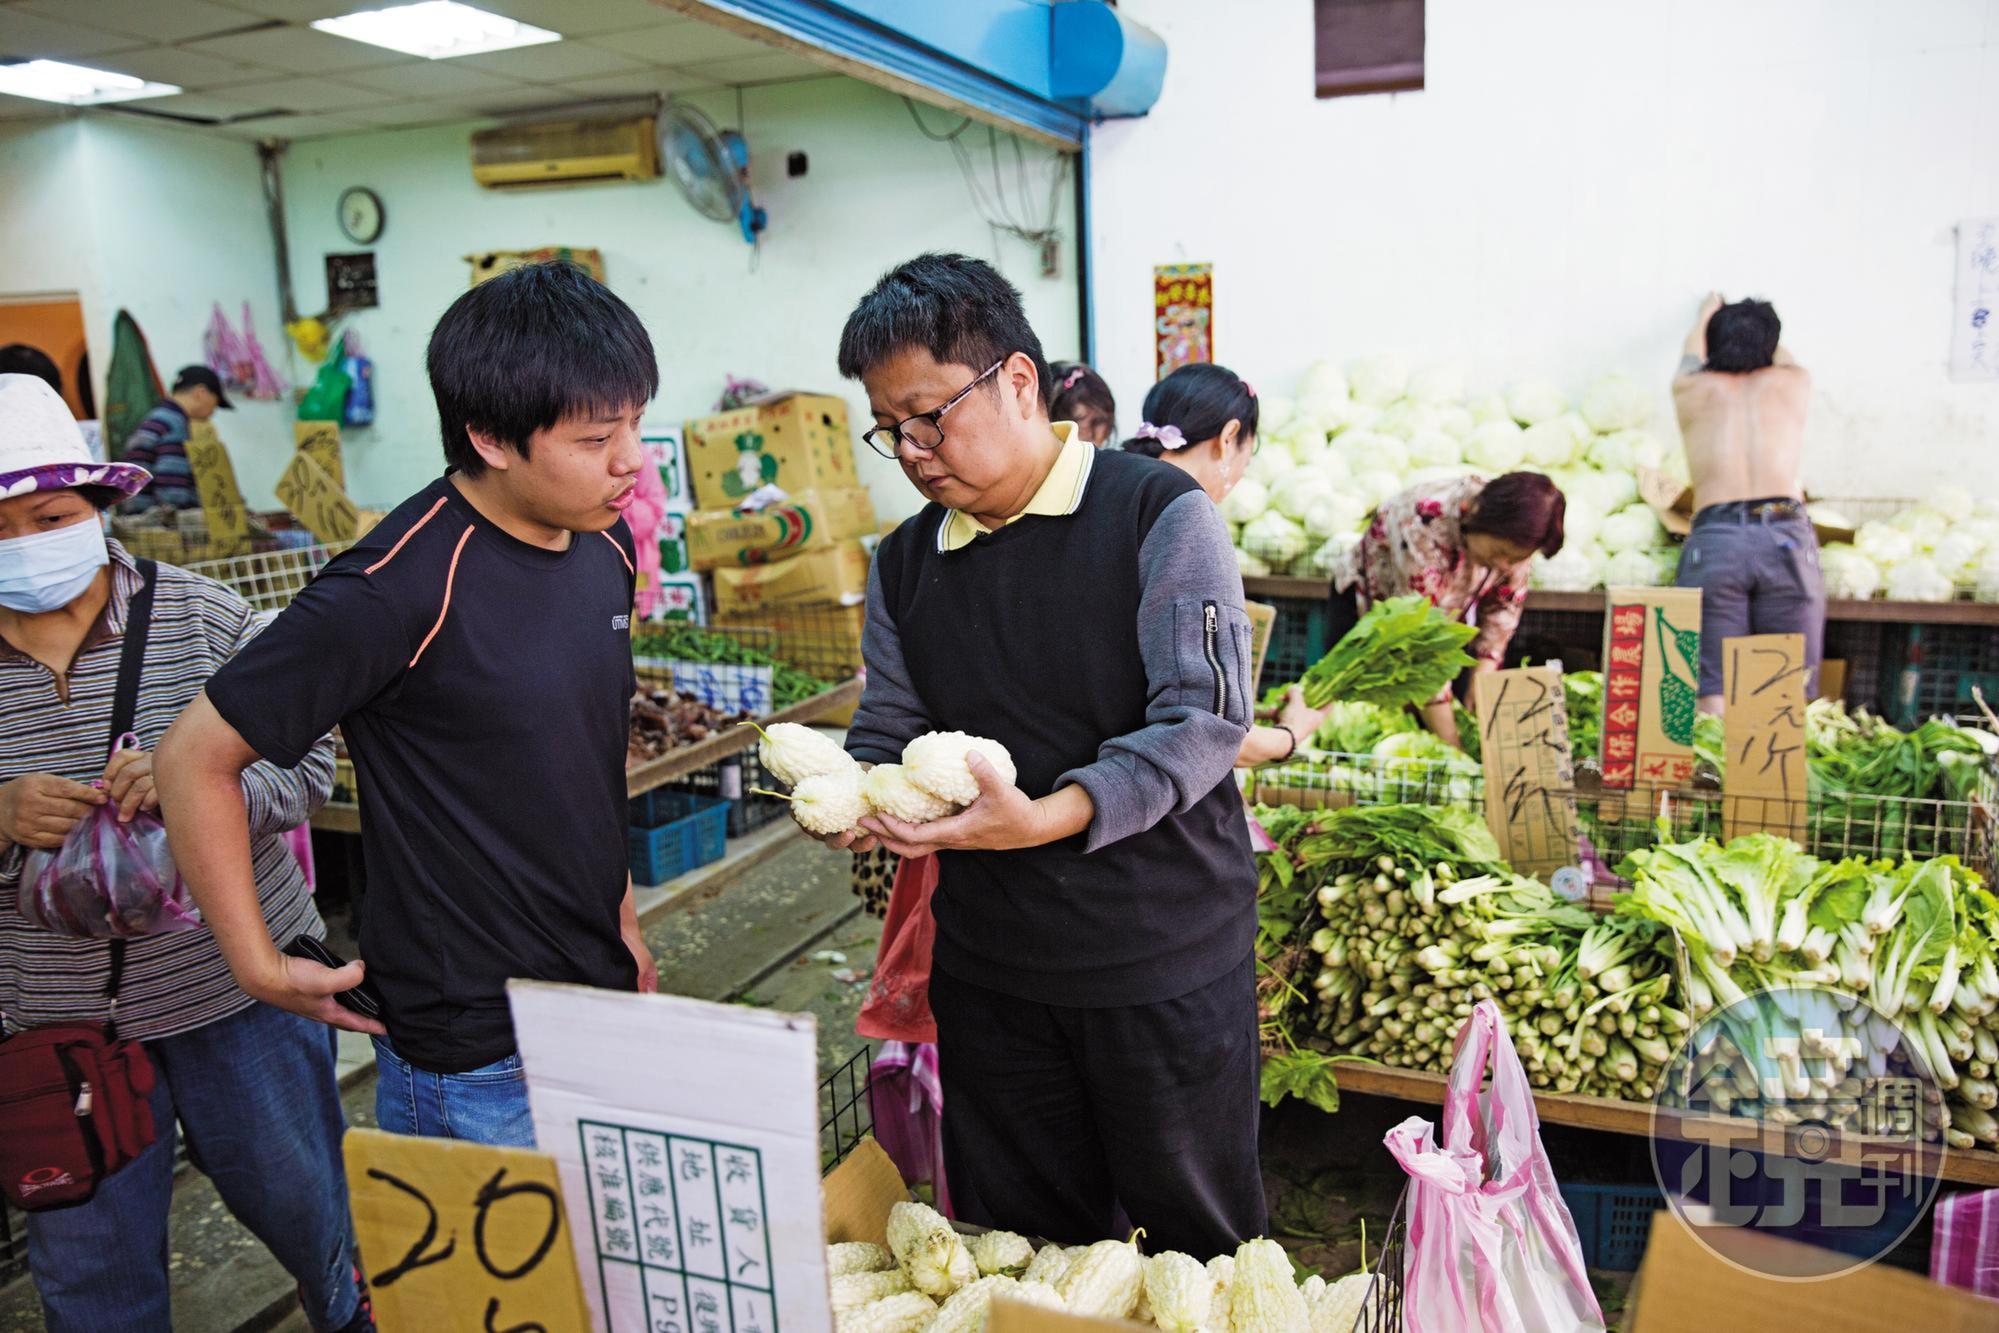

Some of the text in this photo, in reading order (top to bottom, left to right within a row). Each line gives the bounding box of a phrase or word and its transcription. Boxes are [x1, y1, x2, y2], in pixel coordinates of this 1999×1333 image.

[1486, 675, 1554, 740] 12
[366, 1167, 560, 1288] 20
[634, 1139, 675, 1260] 供應代號
[680, 1148, 714, 1247] 地址
[724, 1153, 760, 1276] 收貨人
